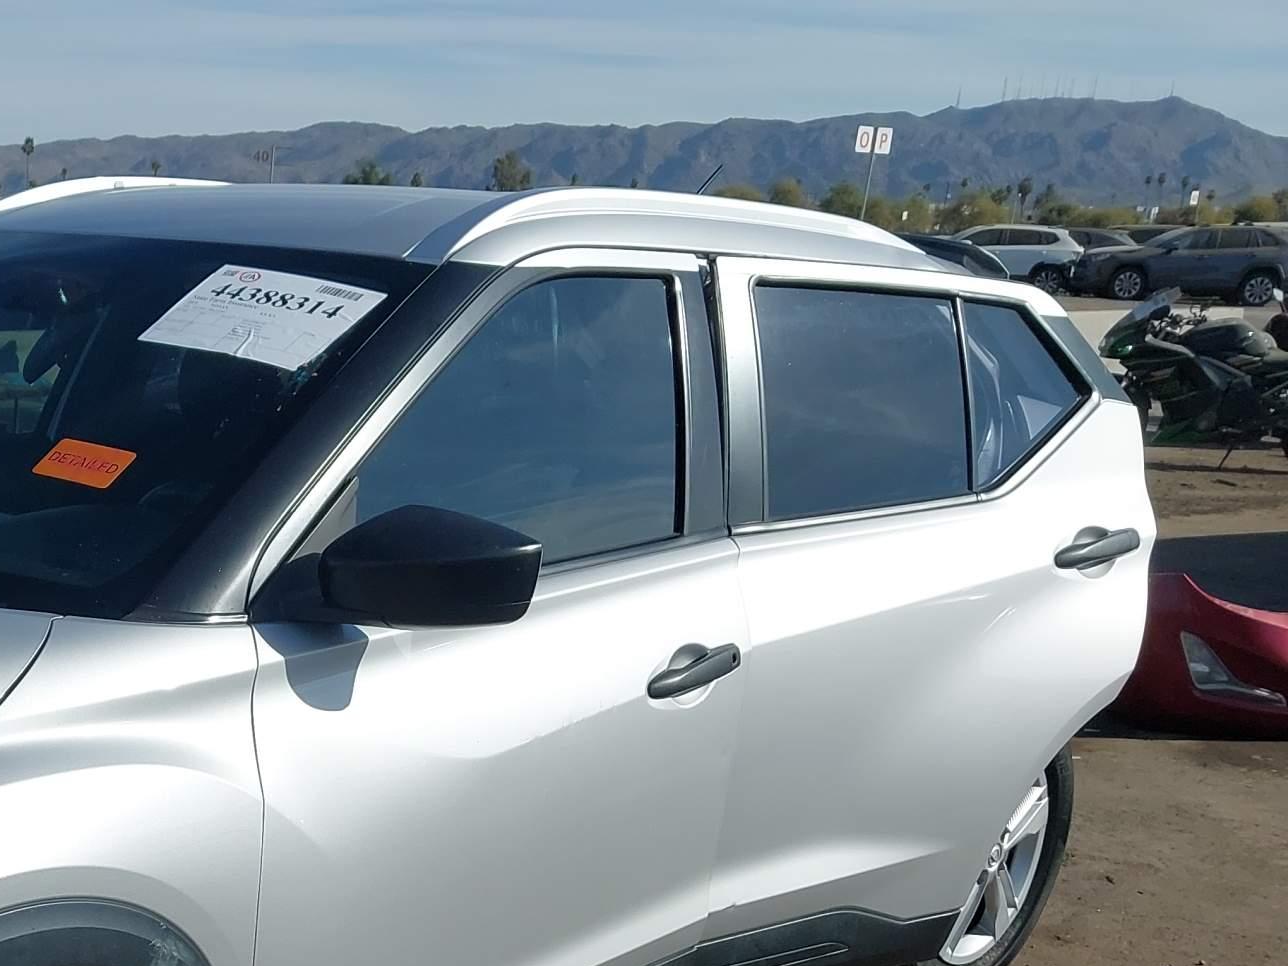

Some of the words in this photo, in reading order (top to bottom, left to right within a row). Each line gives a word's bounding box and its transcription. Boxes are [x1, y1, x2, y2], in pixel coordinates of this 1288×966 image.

[879, 133, 888, 150] P
[210, 282, 346, 319] 44388314
[48, 450, 119, 474] DETAILED
